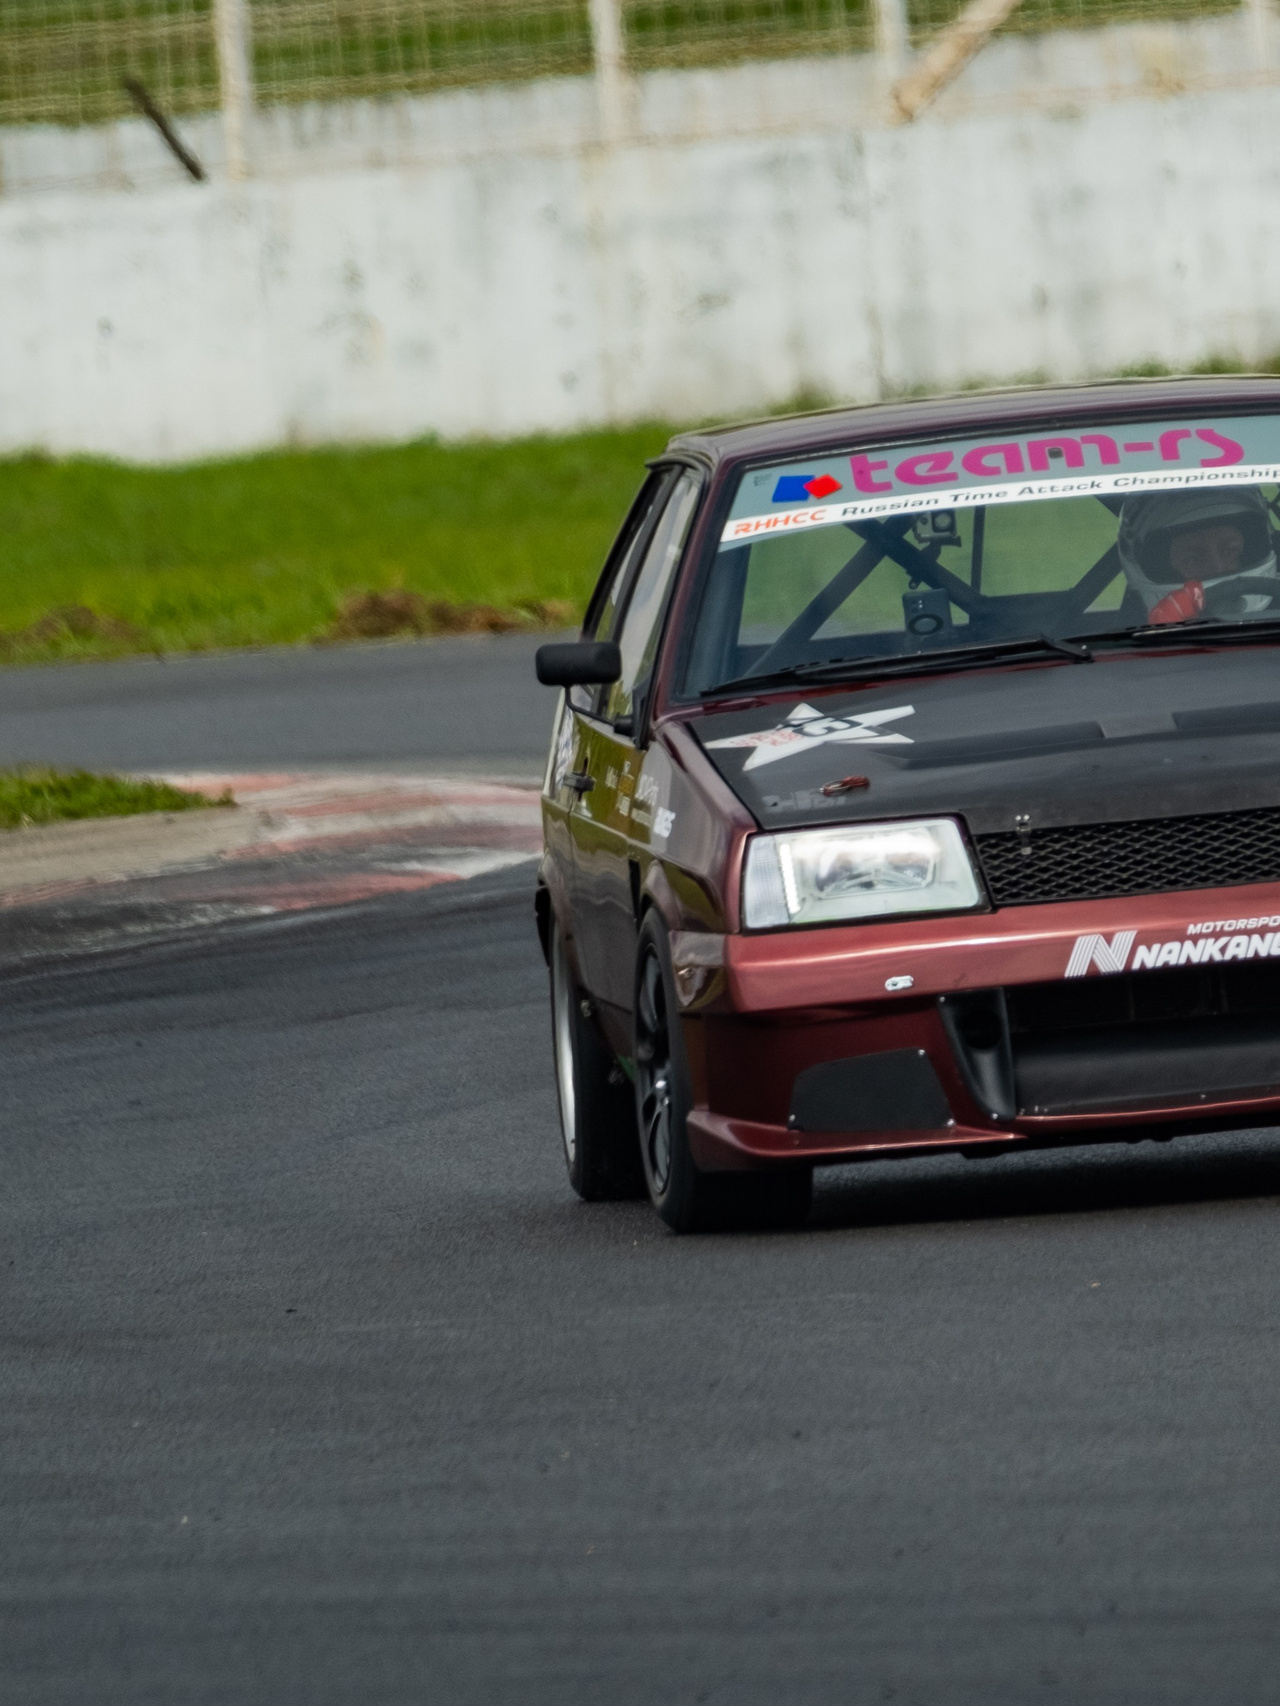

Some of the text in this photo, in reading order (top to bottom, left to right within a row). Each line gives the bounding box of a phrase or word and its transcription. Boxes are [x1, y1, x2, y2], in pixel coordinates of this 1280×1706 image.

[850, 428, 1245, 493] team-rs
[734, 508, 827, 536] RHHCC
[841, 496, 939, 517] Russian
[950, 490, 1008, 503] Time
[1017, 480, 1103, 496] Attack
